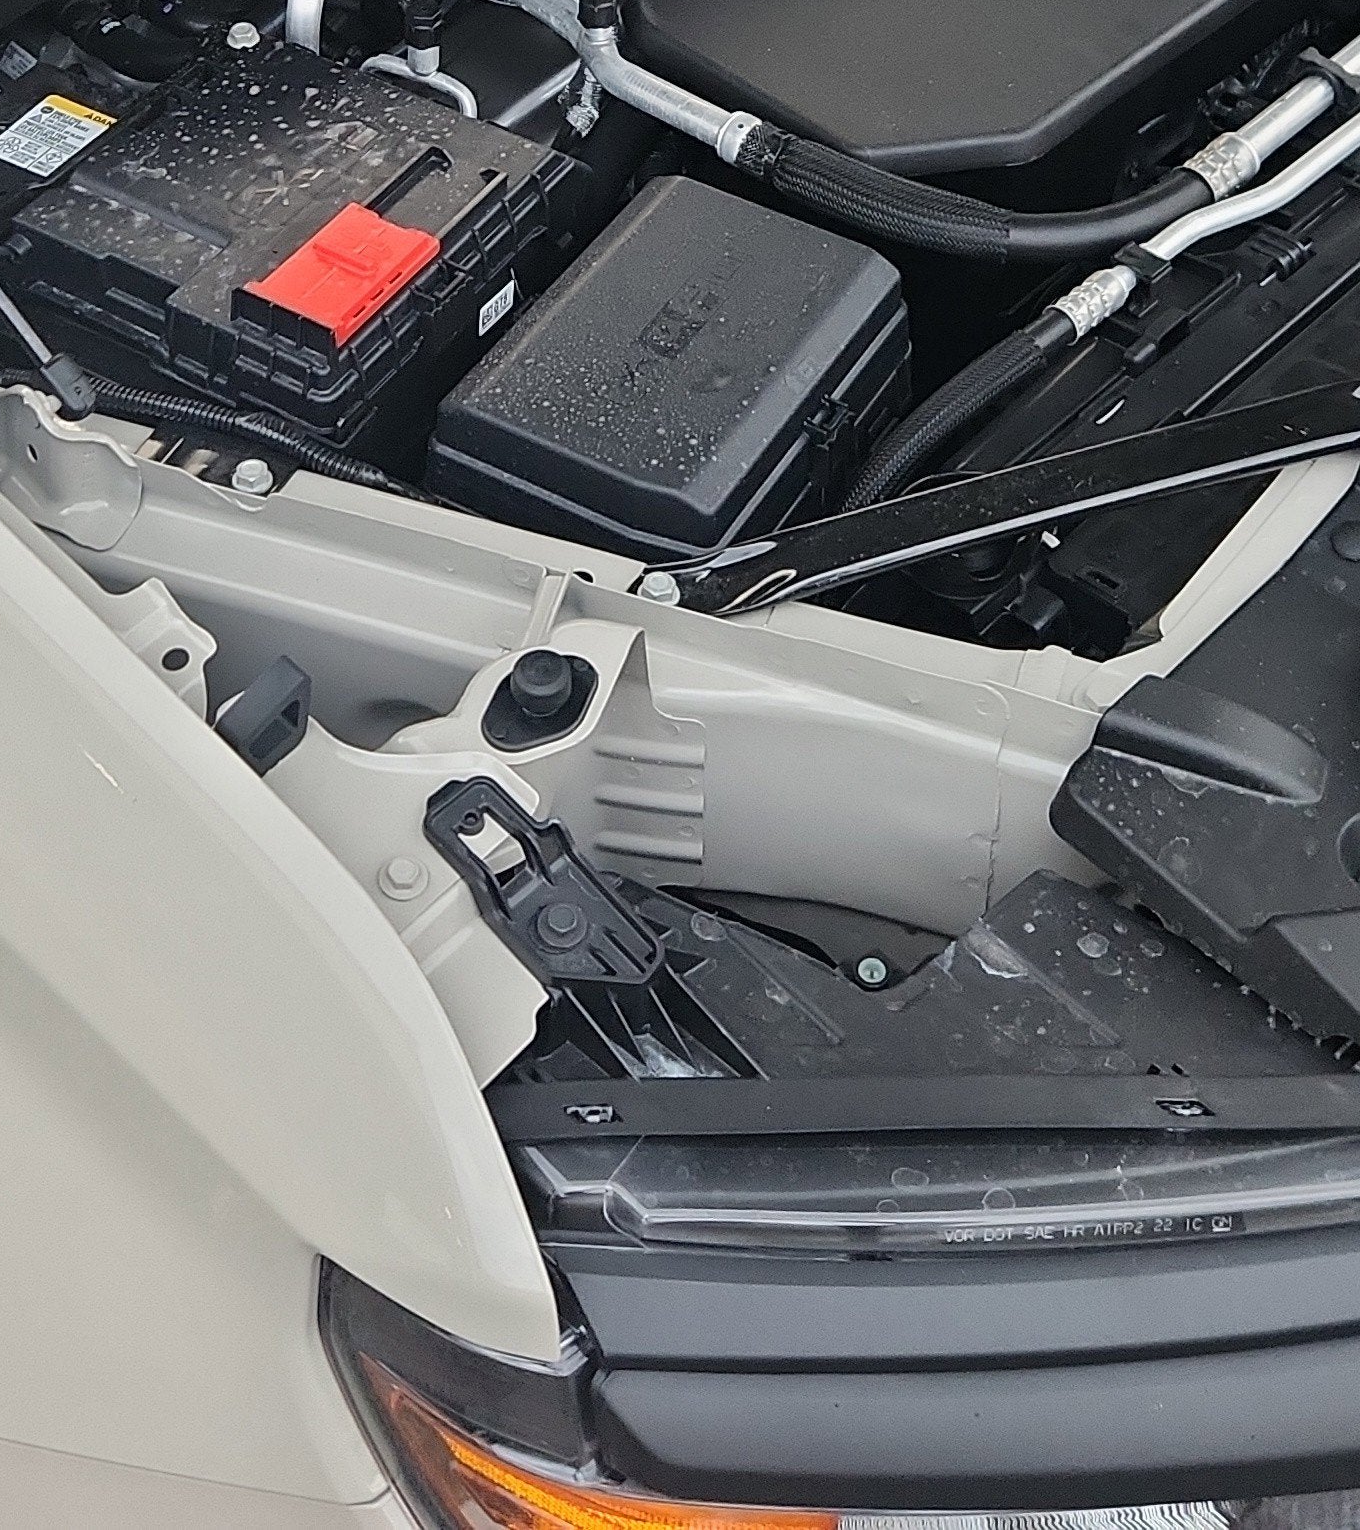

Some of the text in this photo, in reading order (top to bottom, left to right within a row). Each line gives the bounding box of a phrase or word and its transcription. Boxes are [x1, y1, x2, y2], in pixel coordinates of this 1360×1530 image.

[983, 1227, 1014, 1242] DOT
[1024, 1225, 1055, 1240] SAE
[1153, 1217, 1173, 1232] 22
